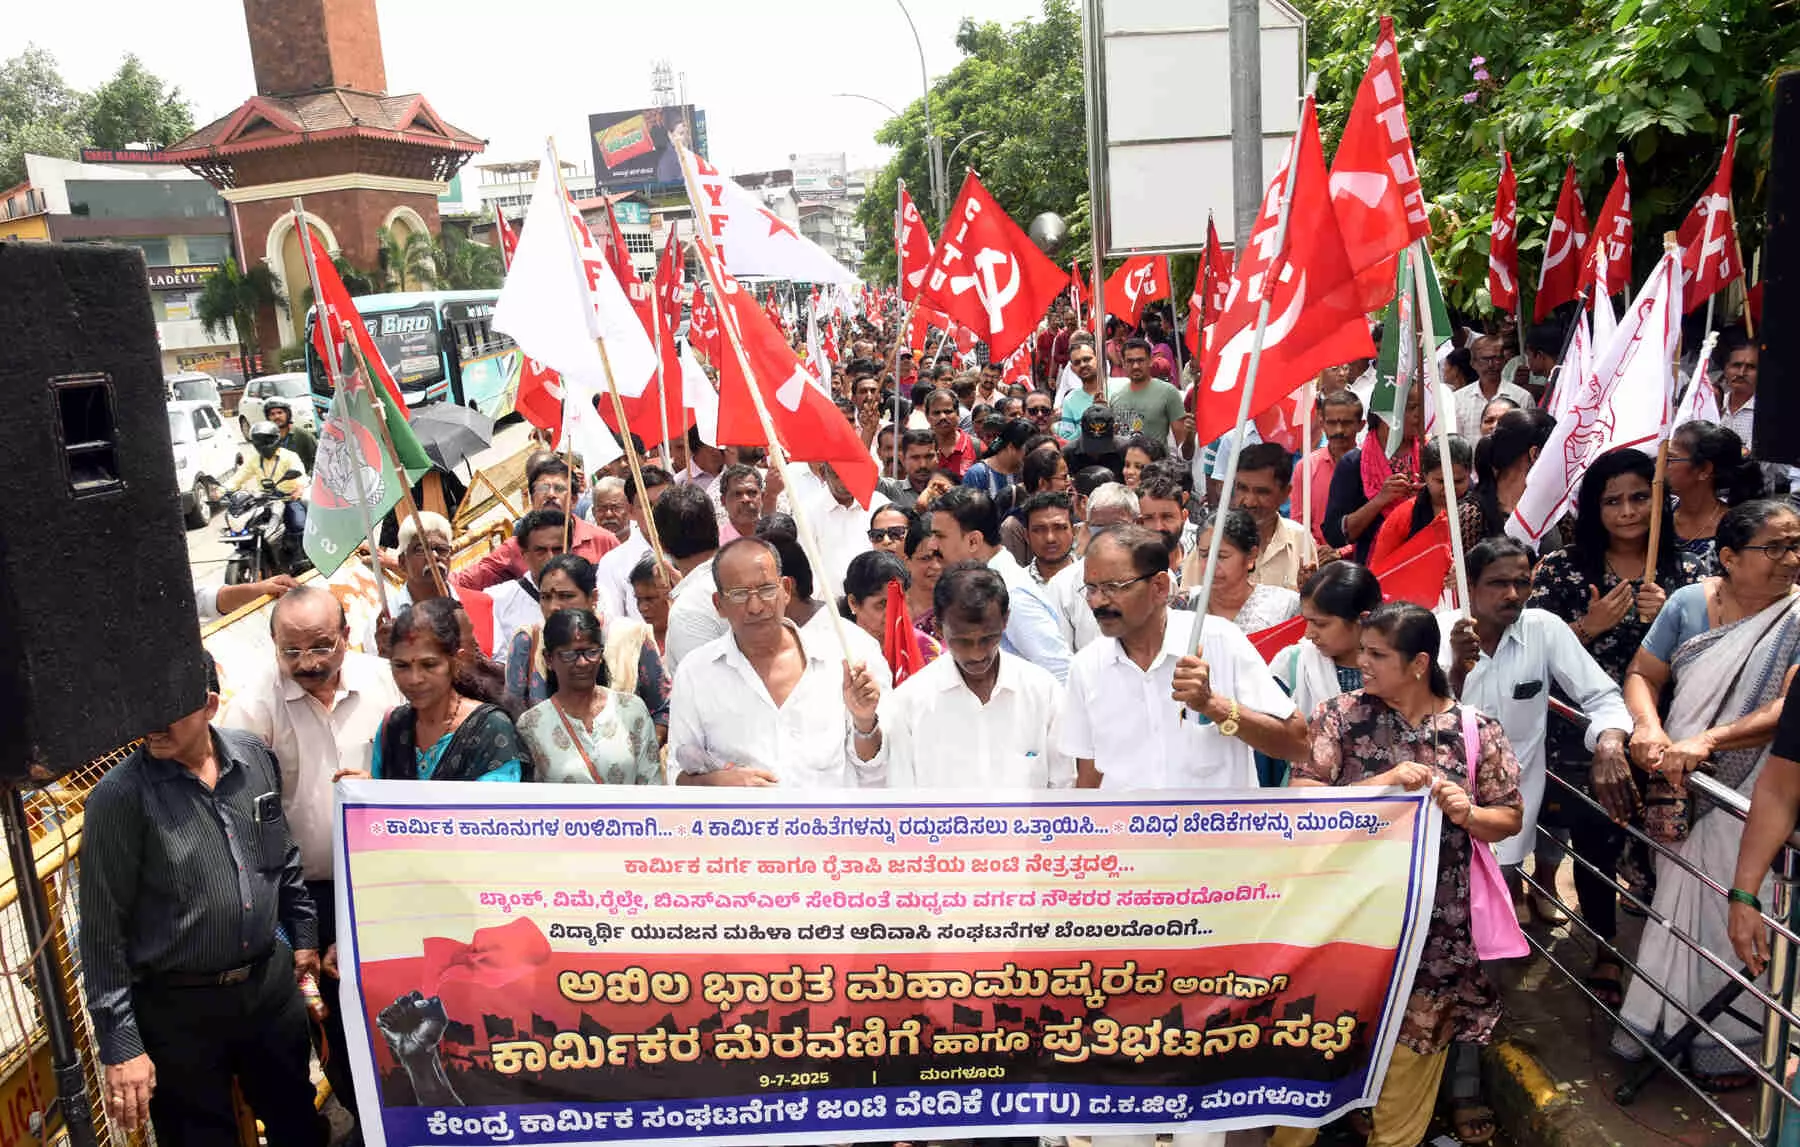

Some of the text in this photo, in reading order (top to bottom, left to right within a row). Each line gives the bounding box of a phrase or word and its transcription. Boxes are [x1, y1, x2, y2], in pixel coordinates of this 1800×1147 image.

[929, 197, 982, 292] CITU
[386, 818, 454, 835] ಕಾರ್ಮಿಕ
[459, 818, 559, 837] ಕಾನೂನುಗಳ
[692, 820, 703, 836] 4
[708, 818, 780, 837] ಕಾರ್ಮಿಕ
[785, 817, 895, 843] ಸಂಹಿತೆಗಳನ್ನು
[899, 816, 1008, 842] ರದ್ದುಪಡಿಸಲು
[1014, 814, 1109, 842] ಒತ್ತಾಯಿಸಿ...
[1129, 814, 1178, 836] ವಿವಿಧ
[1183, 812, 1293, 839] ಬೇಡಿಕೆಗಳನ್ನು
[624, 856, 700, 874] ಕಾರ್ಮಿಕ
[706, 857, 752, 874] ವರ್ಗ
[757, 857, 816, 874] ಹಾಗೂ
[823, 855, 882, 880] ರೈತಾಪಿ
[888, 854, 964, 874] ಜನತೆಯ
[971, 855, 1018, 873] ಜಂಟಿ
[806, 890, 891, 909] ಸೇರಿದಂತೆ
[896, 891, 966, 915] ಮಧ್ಯಮ
[973, 891, 1036, 908] ವರ್ಗದ
[1041, 888, 1111, 907] ನೌಕರರ
[549, 922, 625, 946] ವಿದ್ಯಾರ್ಥಿ
[631, 923, 718, 940] ಯುವಜನ
[724, 923, 791, 941] ಮಹಿಳಾ
[798, 923, 845, 941] ದಲಿತ
[851, 923, 931, 941] ಆದಿವಾಸಿ
[937, 922, 1049, 942] ಸಂಘಟನೆಗಳ
[558, 961, 1288, 1012] ಅಖಿಲ ಭಾರತ ಮಹಾಮುಷ್ಕರದ ಅಂಗವಾಗಿ
[490, 1012, 1357, 1076] ಕಾರ್ಮಿಕರ ಮೆರವಣಿಗೆ ಹಾಗೂ ಪ್ರತಿಭಟನಾ ಸಭೆ
[759, 1066, 1006, 1087] 9-7-2025 ಮಂಗಳೂರು
[426, 1110, 514, 1141] ಕೇಂದ್ರ
[519, 1107, 634, 1134] ಕಾರ್ಮಿಕ
[642, 1096, 809, 1132] ಸಂಘಟನೆಗಳ
[816, 1091, 888, 1120] ಜಂಟಿ
[896, 1087, 984, 1117] ವೇದಿಕೆ
[991, 1090, 1081, 1117] (JCTU)
[1200, 1085, 1332, 1109] ಮಂಗಳೂರು
